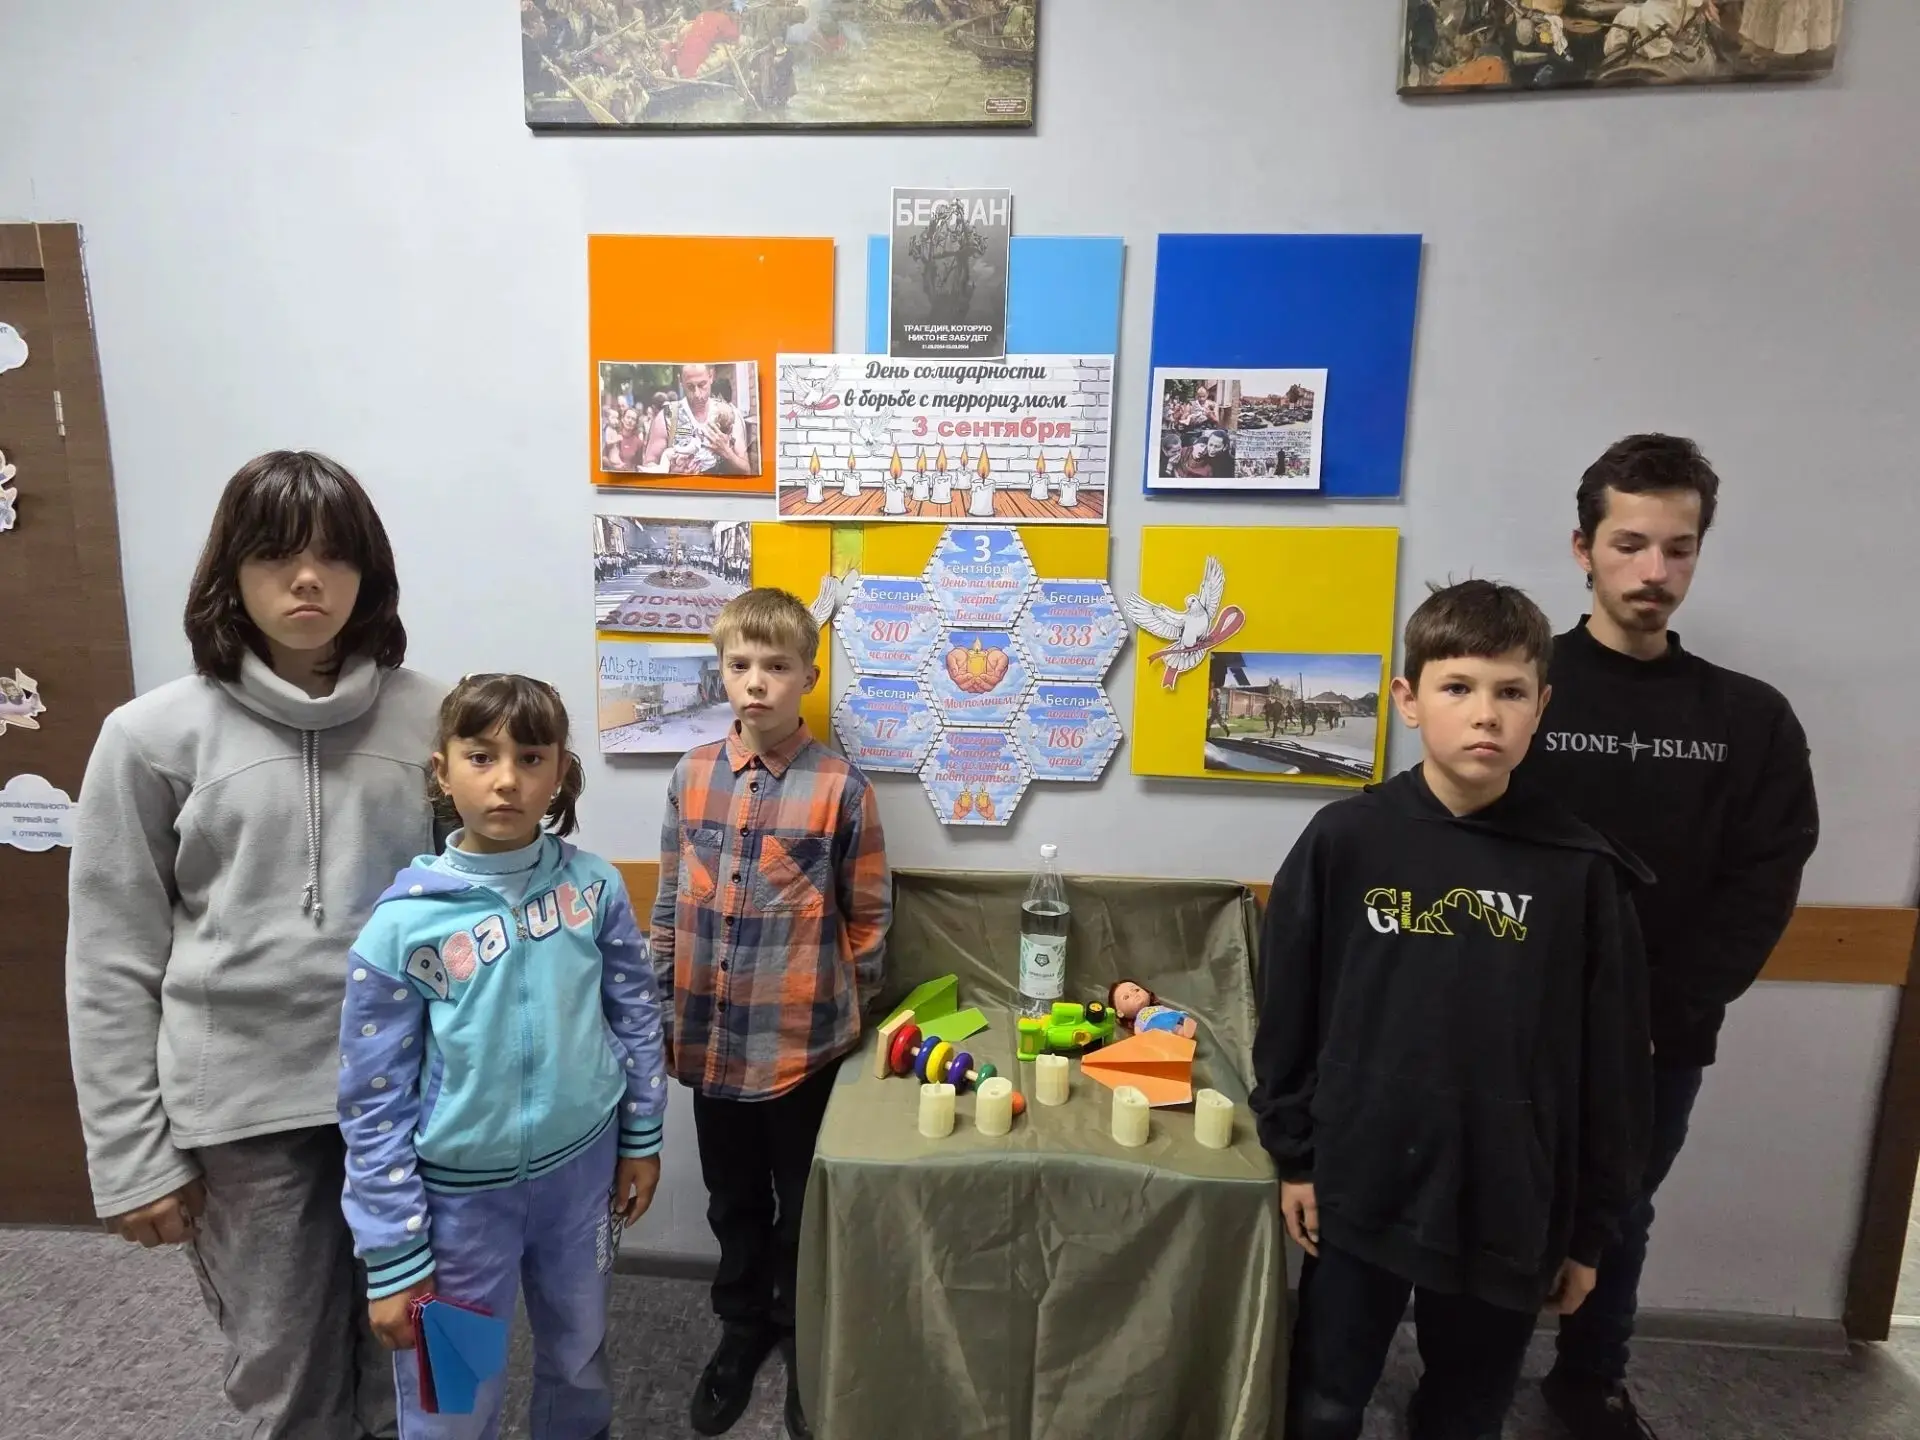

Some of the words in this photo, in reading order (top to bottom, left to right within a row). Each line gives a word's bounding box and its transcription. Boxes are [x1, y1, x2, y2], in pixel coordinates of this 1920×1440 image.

[903, 324, 950, 333] ТРАГЕДИЯ,
[949, 334, 988, 342] ЗАБУДЕТ
[865, 361, 909, 381] День
[913, 362, 1047, 384] солидарности
[844, 388, 856, 407] в
[859, 388, 916, 411] борьбе
[919, 395, 930, 408] с
[932, 392, 1068, 413] терроризмом
[911, 416, 929, 437] 3
[937, 416, 1072, 443] сентября
[973, 534, 991, 562] 3
[946, 562, 1010, 576] сентября
[940, 576, 966, 588] День
[968, 579, 1020, 589] памяти
[858, 587, 866, 598] В
[870, 587, 925, 601] Беслане
[1050, 591, 1106, 604] Беслане
[956, 609, 1003, 621] Беслана
[871, 618, 910, 642] 810
[1048, 624, 1093, 647] 333
[868, 650, 912, 661] человек
[1045, 654, 1097, 666] человека
[856, 686, 864, 696] В
[867, 686, 922, 700] Беслане
[1033, 694, 1041, 705] В
[1046, 694, 1102, 706] Беслане
[876, 718, 899, 738] 17
[1048, 726, 1085, 748] 186
[1545, 732, 1619, 754] STONE
[1652, 738, 1728, 762] ISLAND
[1048, 755, 1083, 768] детей
